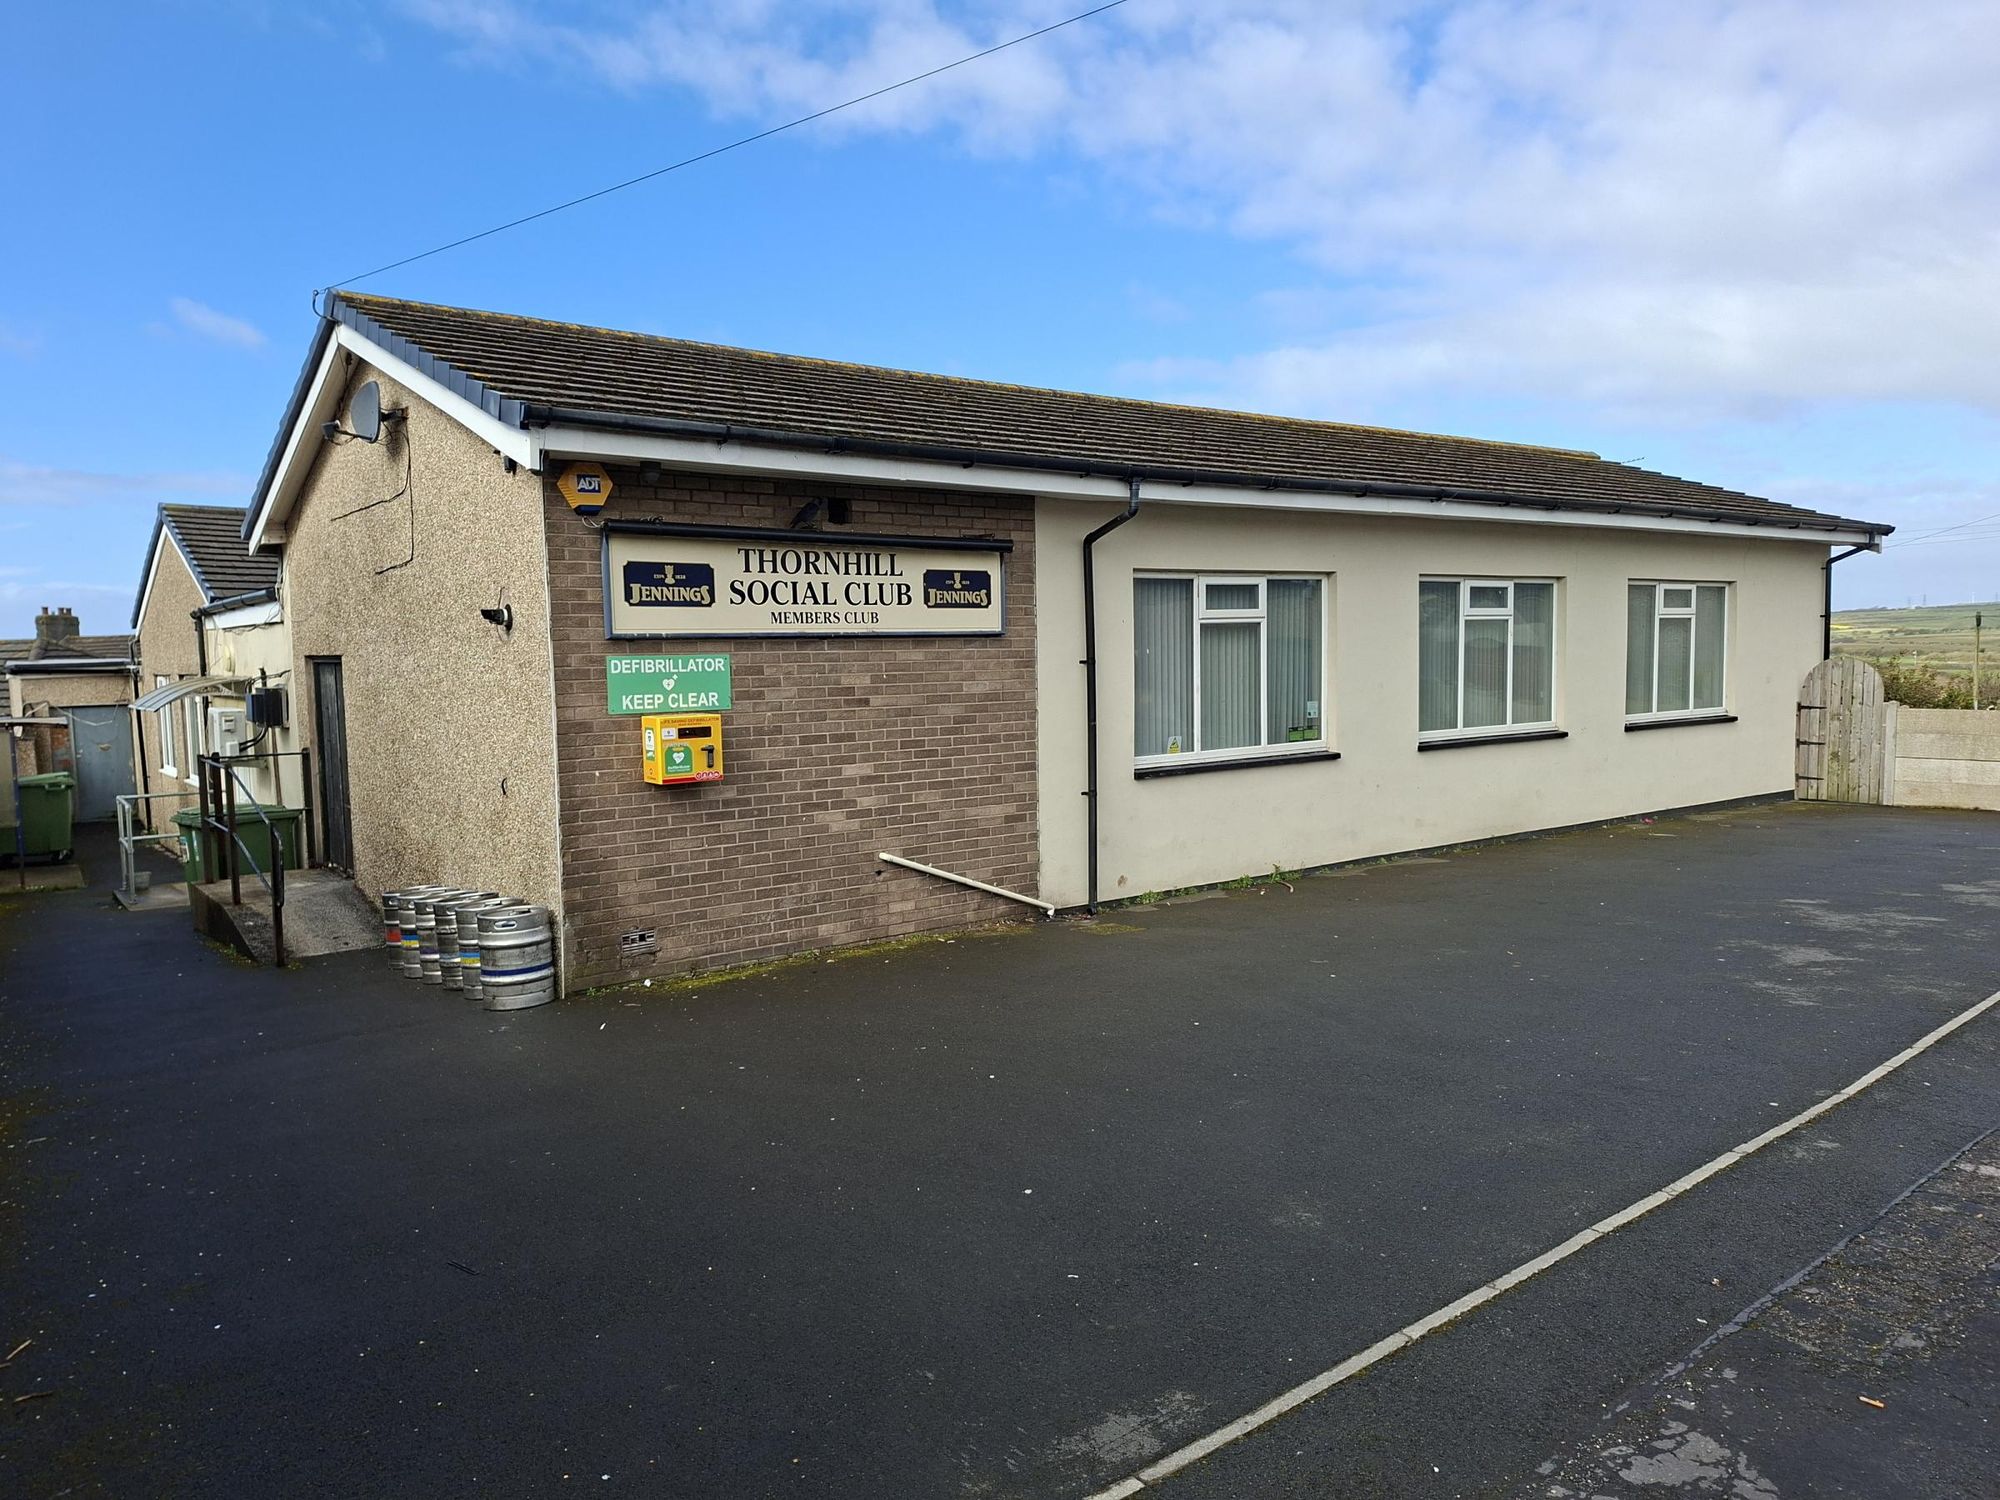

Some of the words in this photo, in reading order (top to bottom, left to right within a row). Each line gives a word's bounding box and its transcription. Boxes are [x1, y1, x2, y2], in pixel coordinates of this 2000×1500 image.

[577, 477, 601, 491] ADT
[737, 548, 904, 577] THORNHILL
[629, 583, 711, 605] JENNINGS
[729, 579, 838, 606] SOCIAL
[844, 581, 913, 607] CLUB
[927, 588, 989, 606] JENNINGS
[770, 611, 841, 625] MEMBERS
[844, 611, 880, 625] CLUB
[610, 658, 725, 674] DEFIBRILLATOR
[622, 694, 664, 710] KEEP
[668, 692, 720, 708] CLEAR
